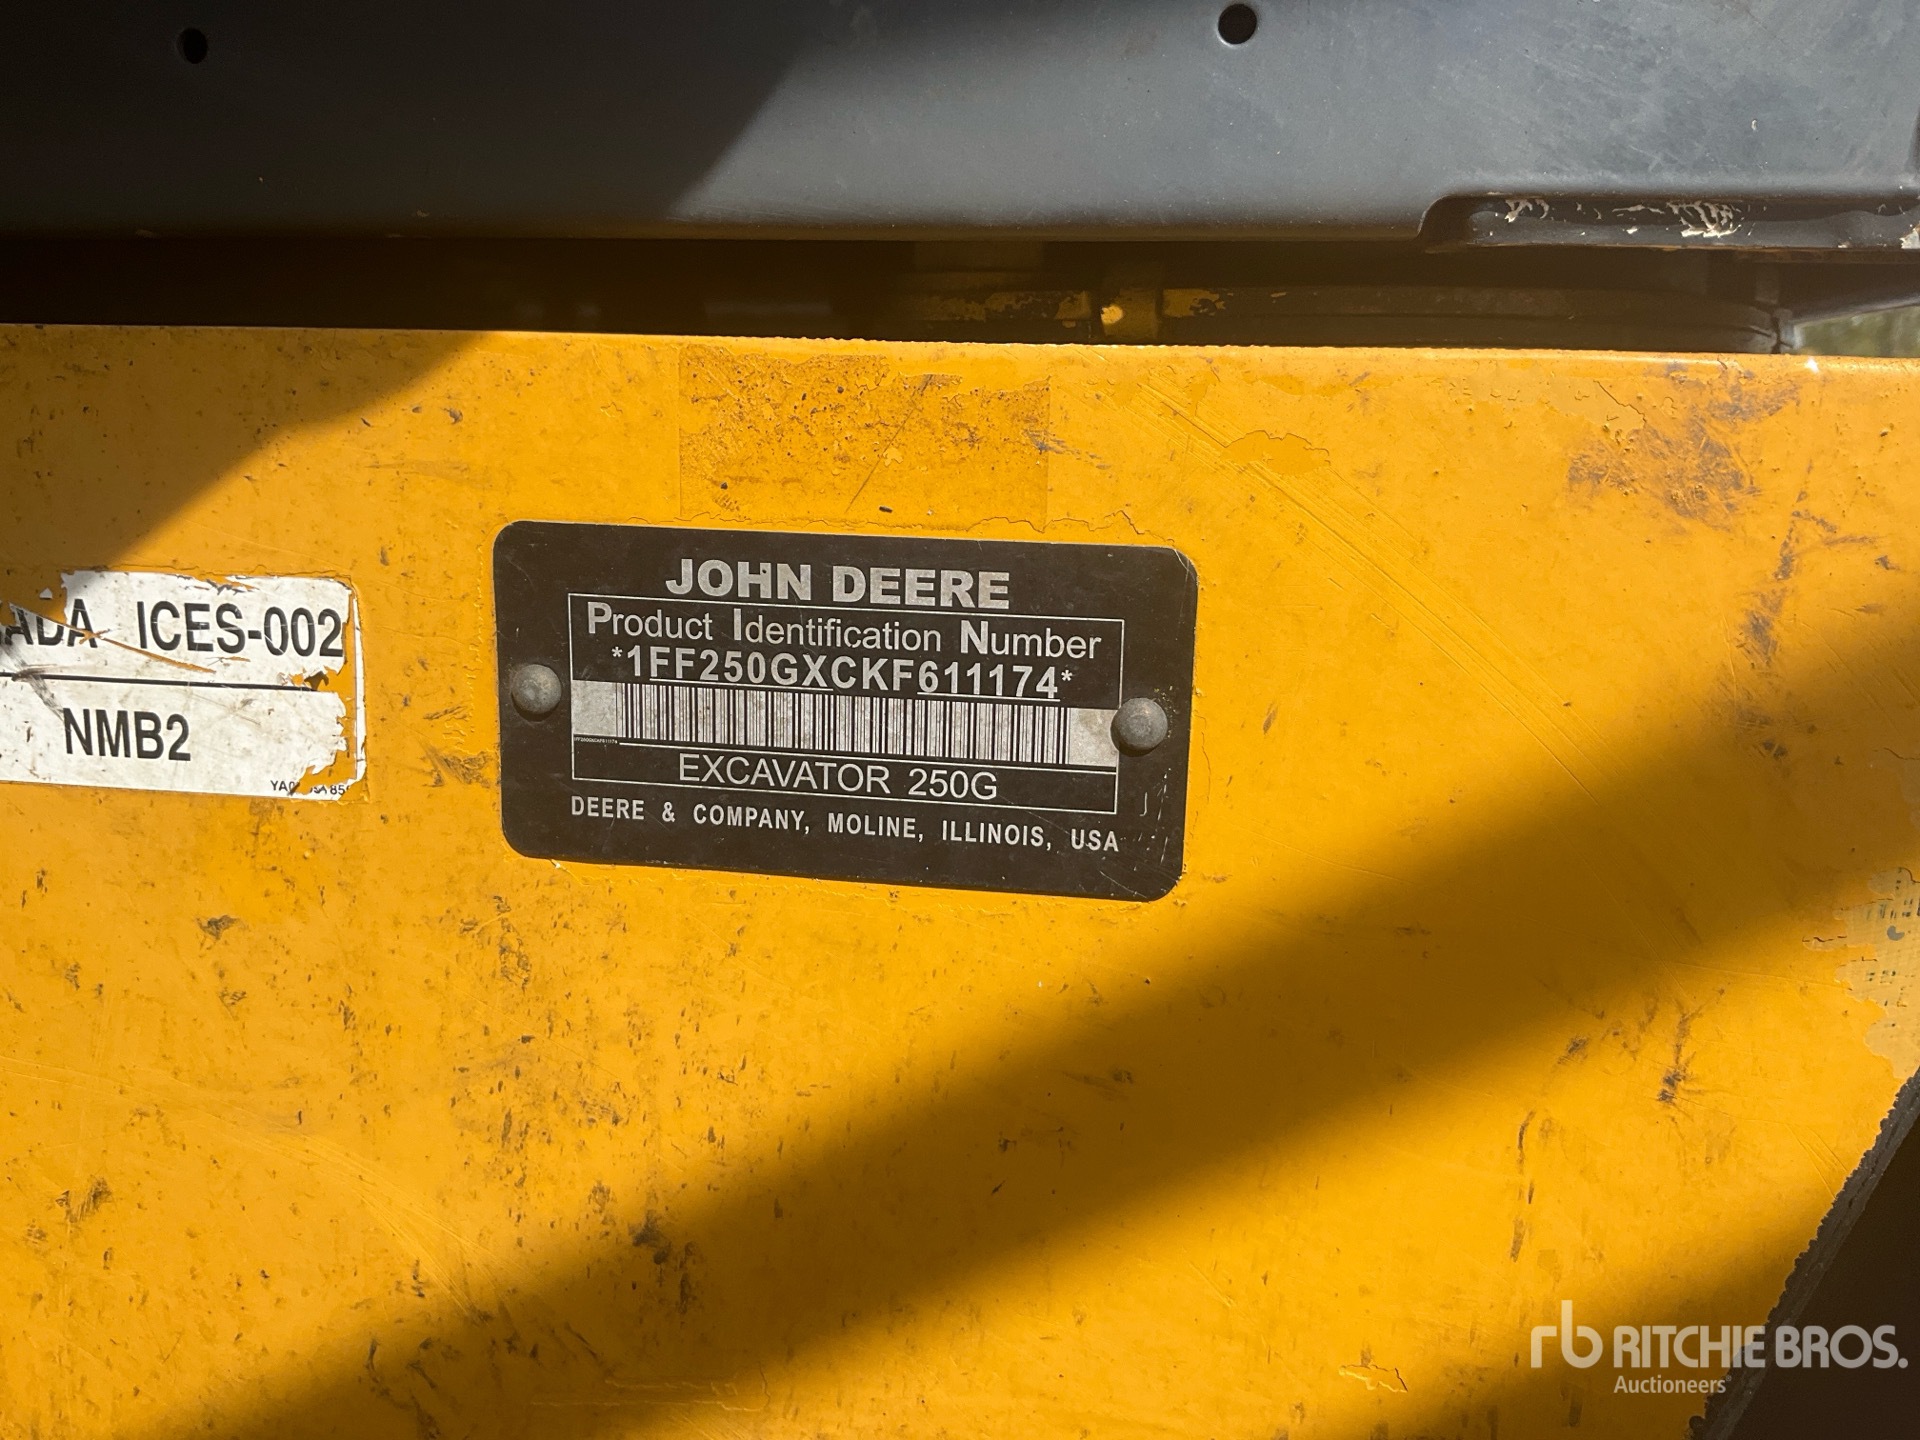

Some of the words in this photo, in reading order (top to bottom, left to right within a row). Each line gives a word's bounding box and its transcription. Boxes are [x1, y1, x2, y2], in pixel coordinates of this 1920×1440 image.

[665, 558, 811, 600] JOHN
[832, 565, 1010, 610] DEERE
[136, 601, 344, 658] ICES-002
[587, 601, 713, 641] Product
[733, 608, 942, 652] Identification
[960, 619, 1102, 659] Number
[63, 707, 191, 762] NMB2
[679, 753, 890, 794] EXCAVATOR
[908, 768, 998, 800] 250G
[571, 796, 645, 820] DEERE
[662, 801, 676, 822] &
[693, 803, 810, 835] COMPANY,
[828, 812, 923, 842] MOLINE,
[942, 820, 1051, 851] ILLINOIS,
[1070, 828, 1119, 852] USA
